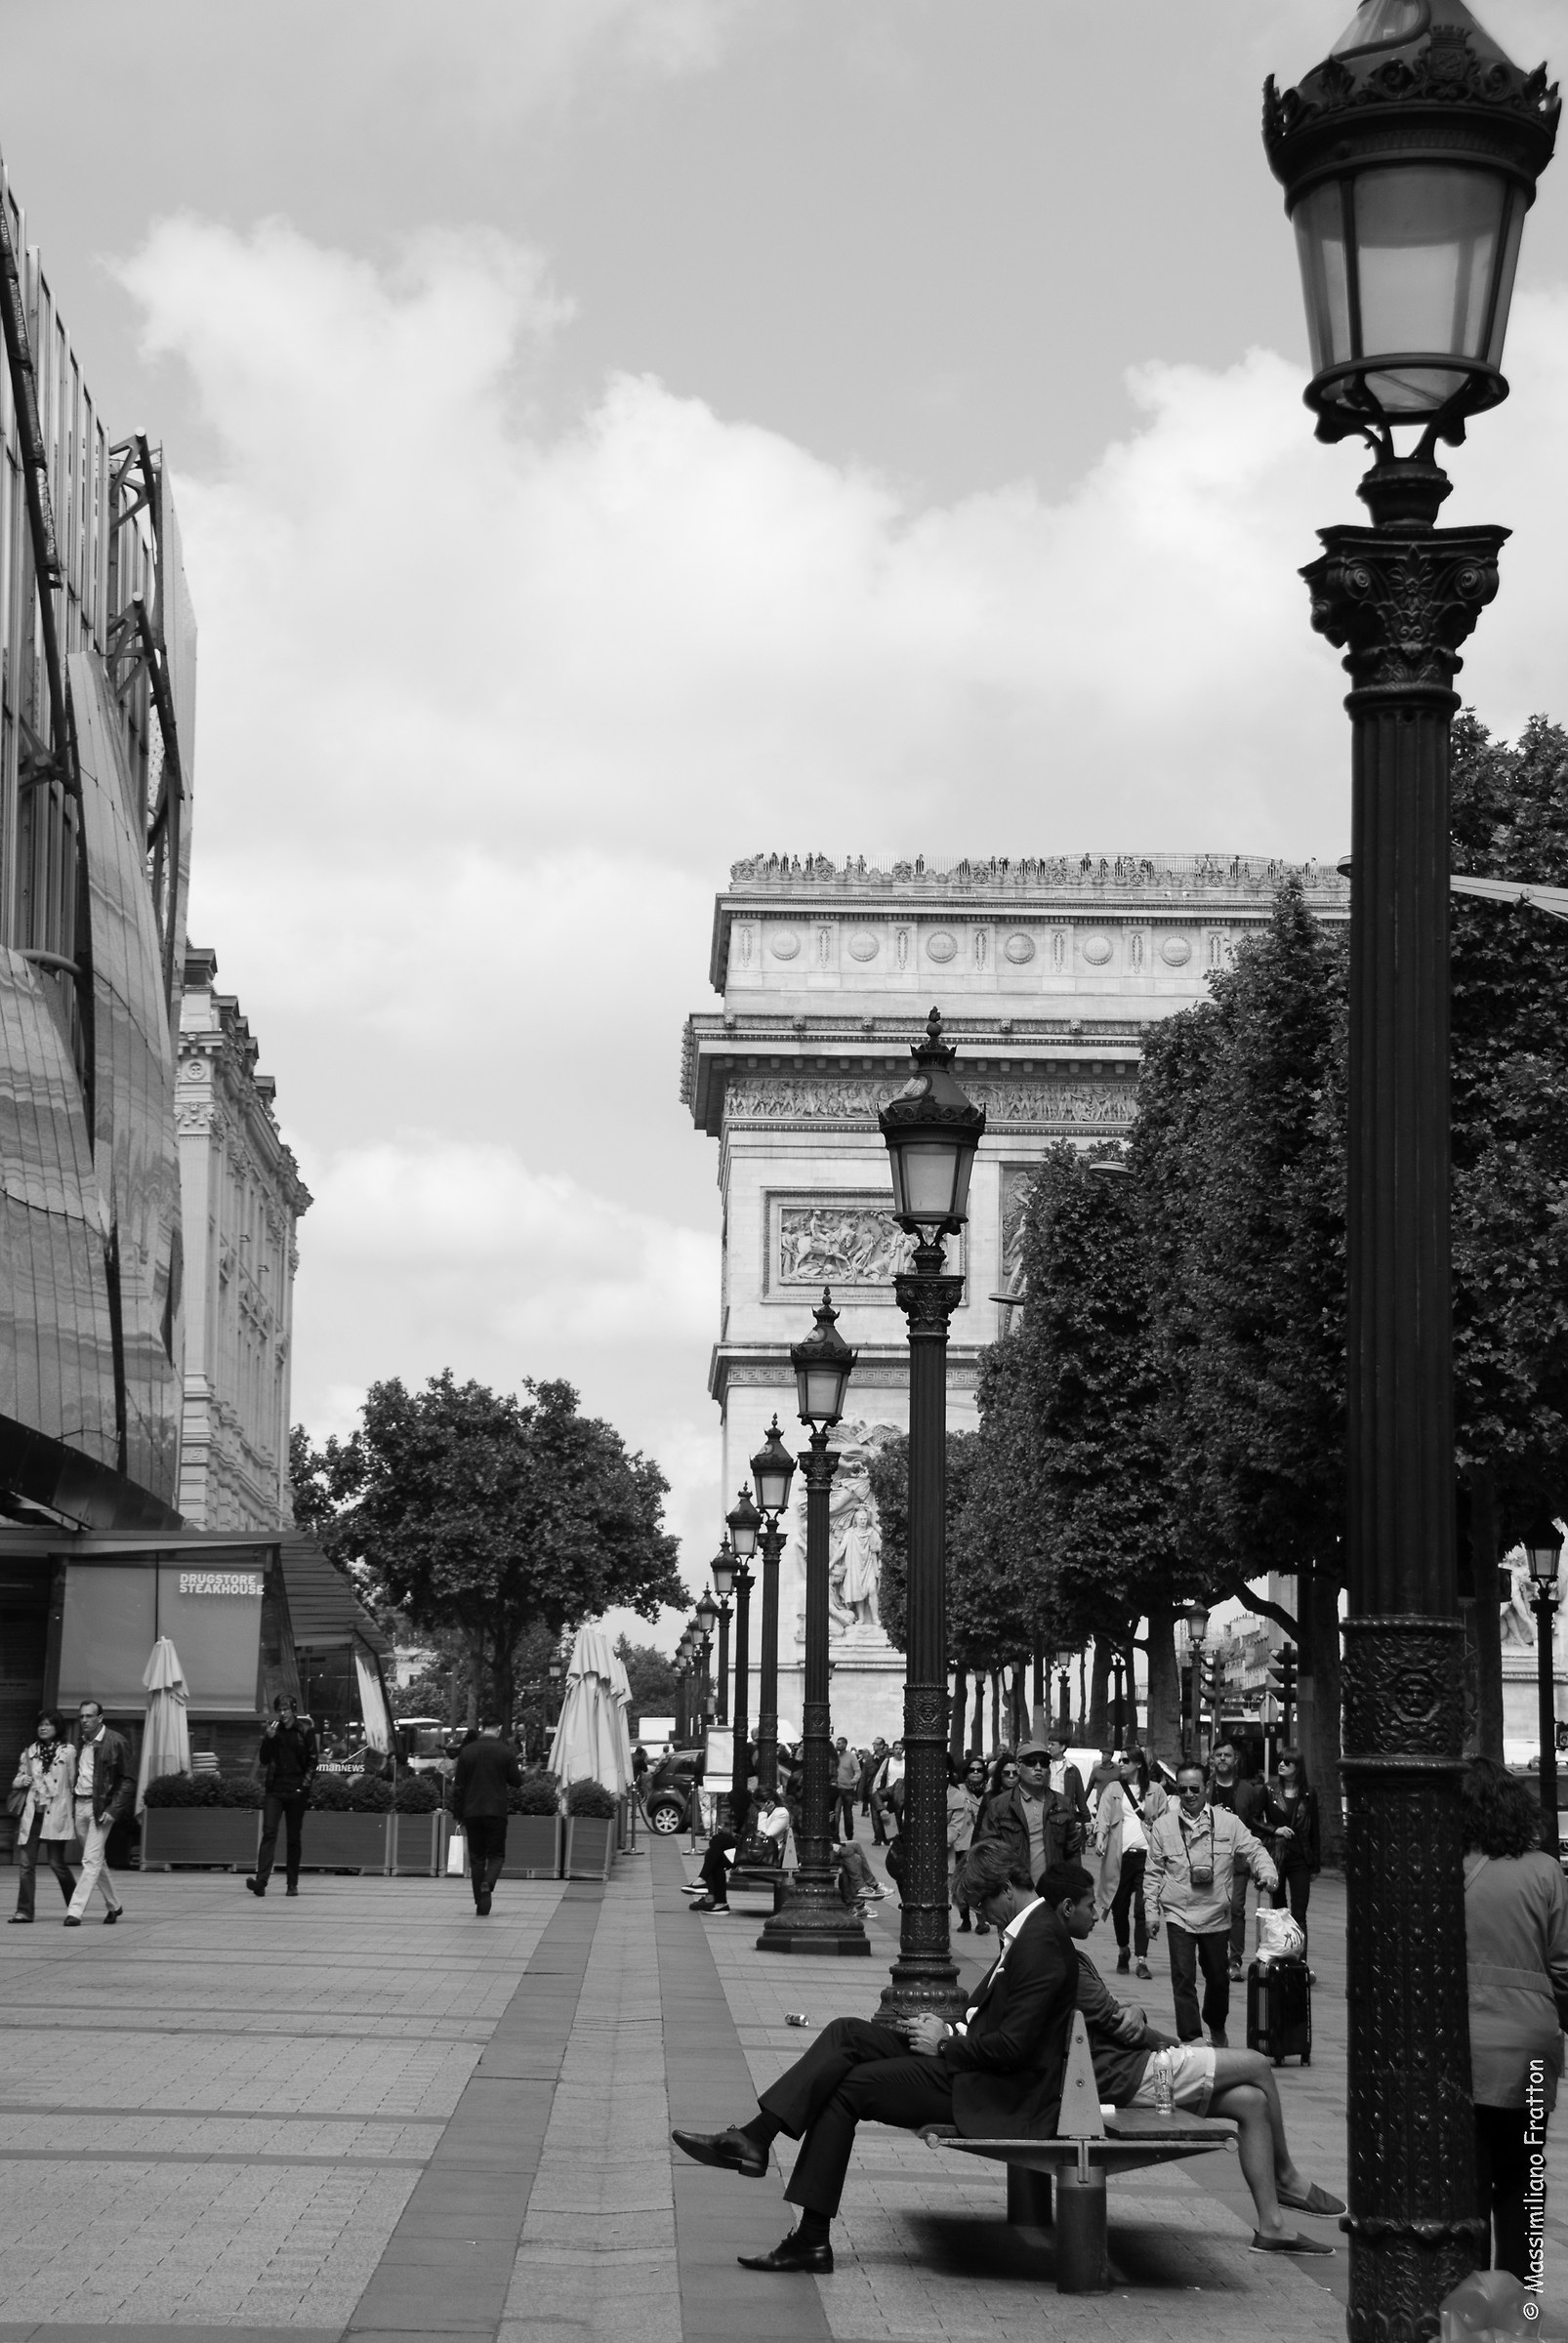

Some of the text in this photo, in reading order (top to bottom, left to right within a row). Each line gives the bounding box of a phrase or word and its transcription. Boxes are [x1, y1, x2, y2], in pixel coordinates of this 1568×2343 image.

[180, 1573, 257, 1585] DRUGSTORE
[180, 1583, 265, 1595] STEAKHOUSE
[1231, 1725, 1246, 1736] 73
